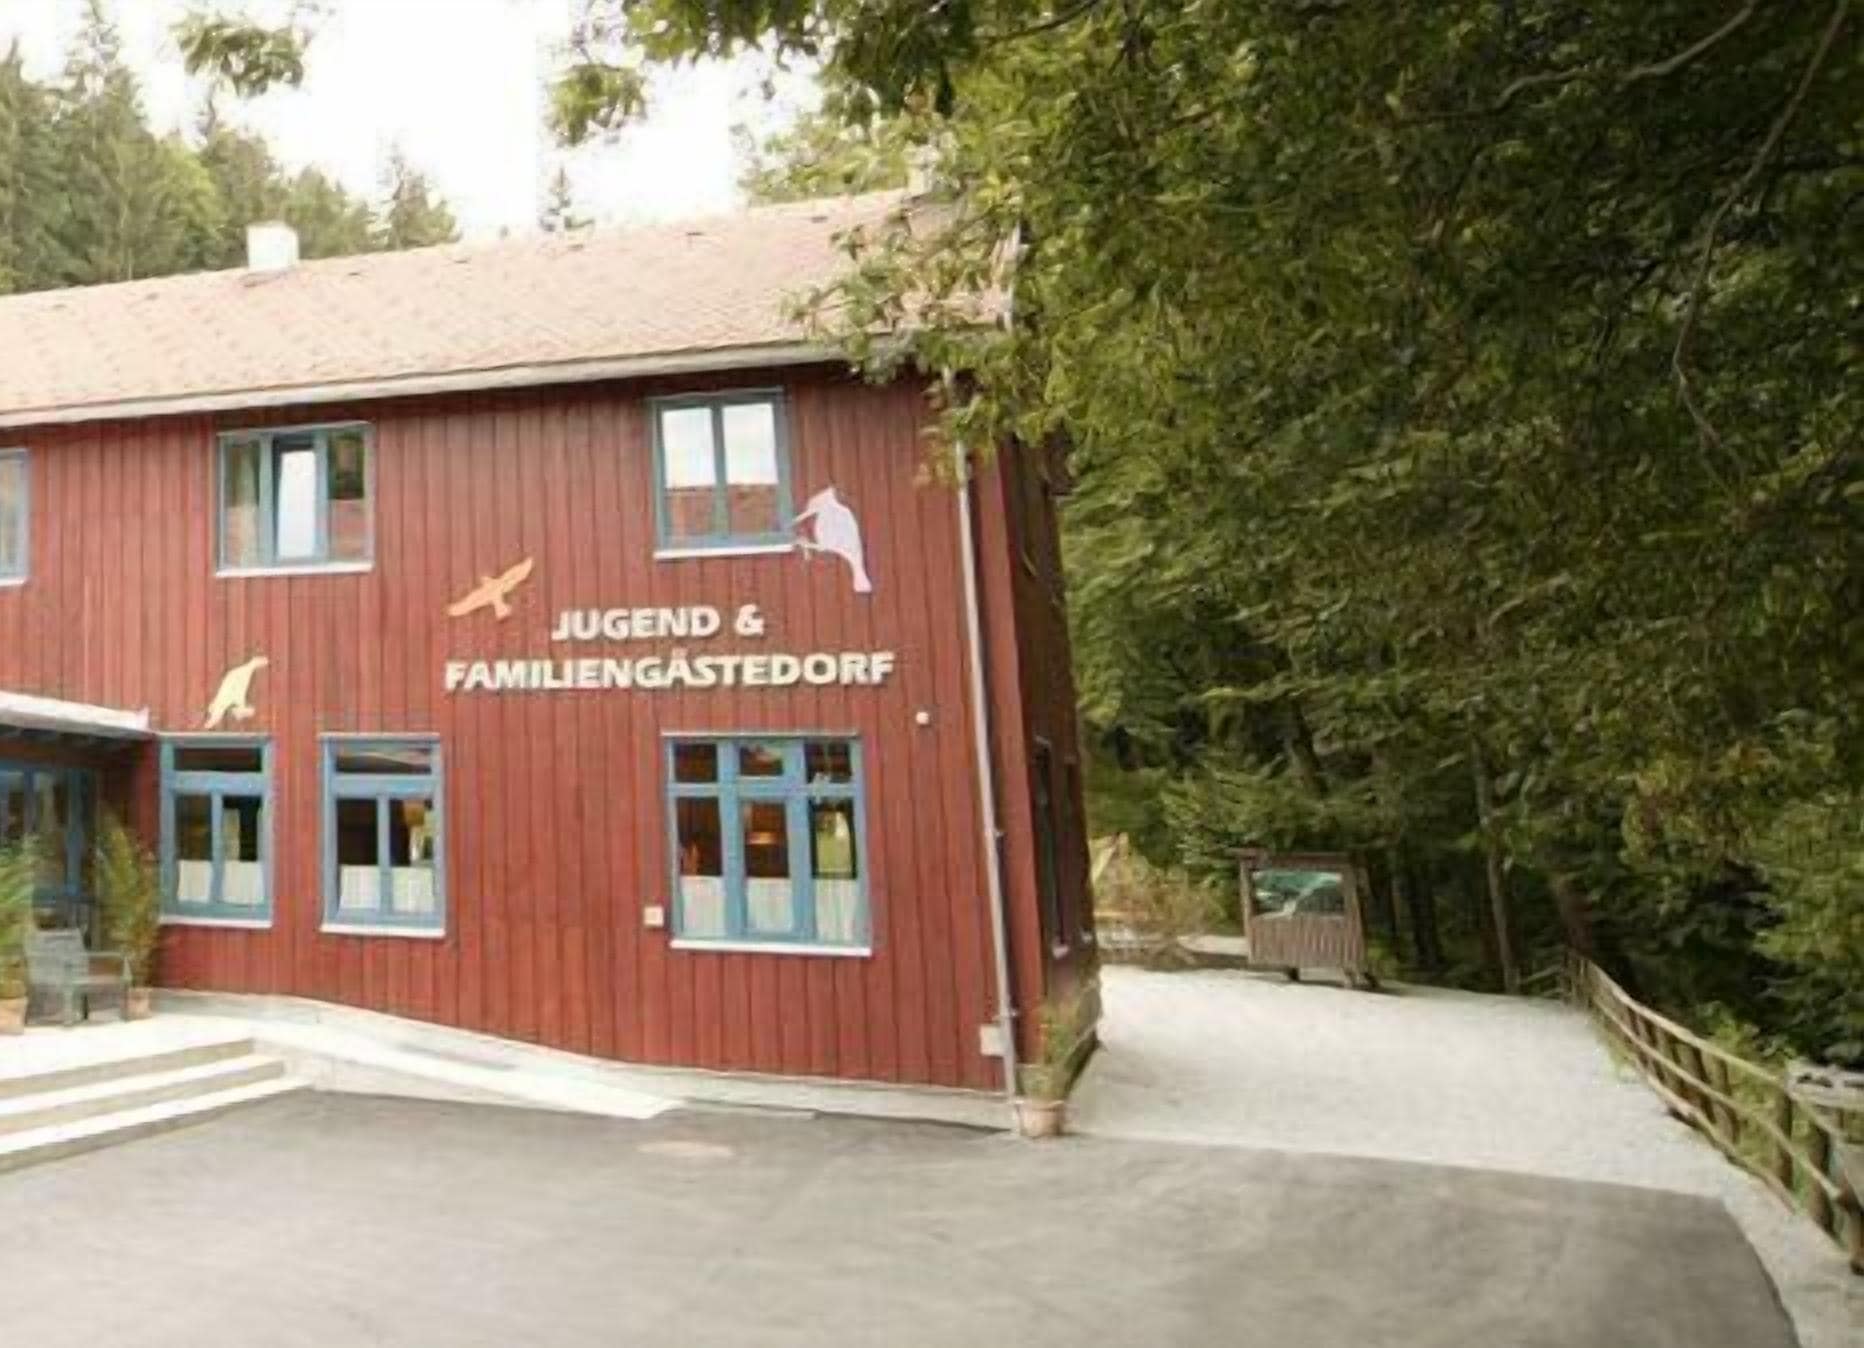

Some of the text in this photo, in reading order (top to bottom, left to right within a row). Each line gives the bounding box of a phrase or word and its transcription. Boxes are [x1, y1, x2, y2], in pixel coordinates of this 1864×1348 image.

[551, 603, 766, 642] JUGEND &
[444, 648, 897, 691] FAMILIENGÄSTEDORF
